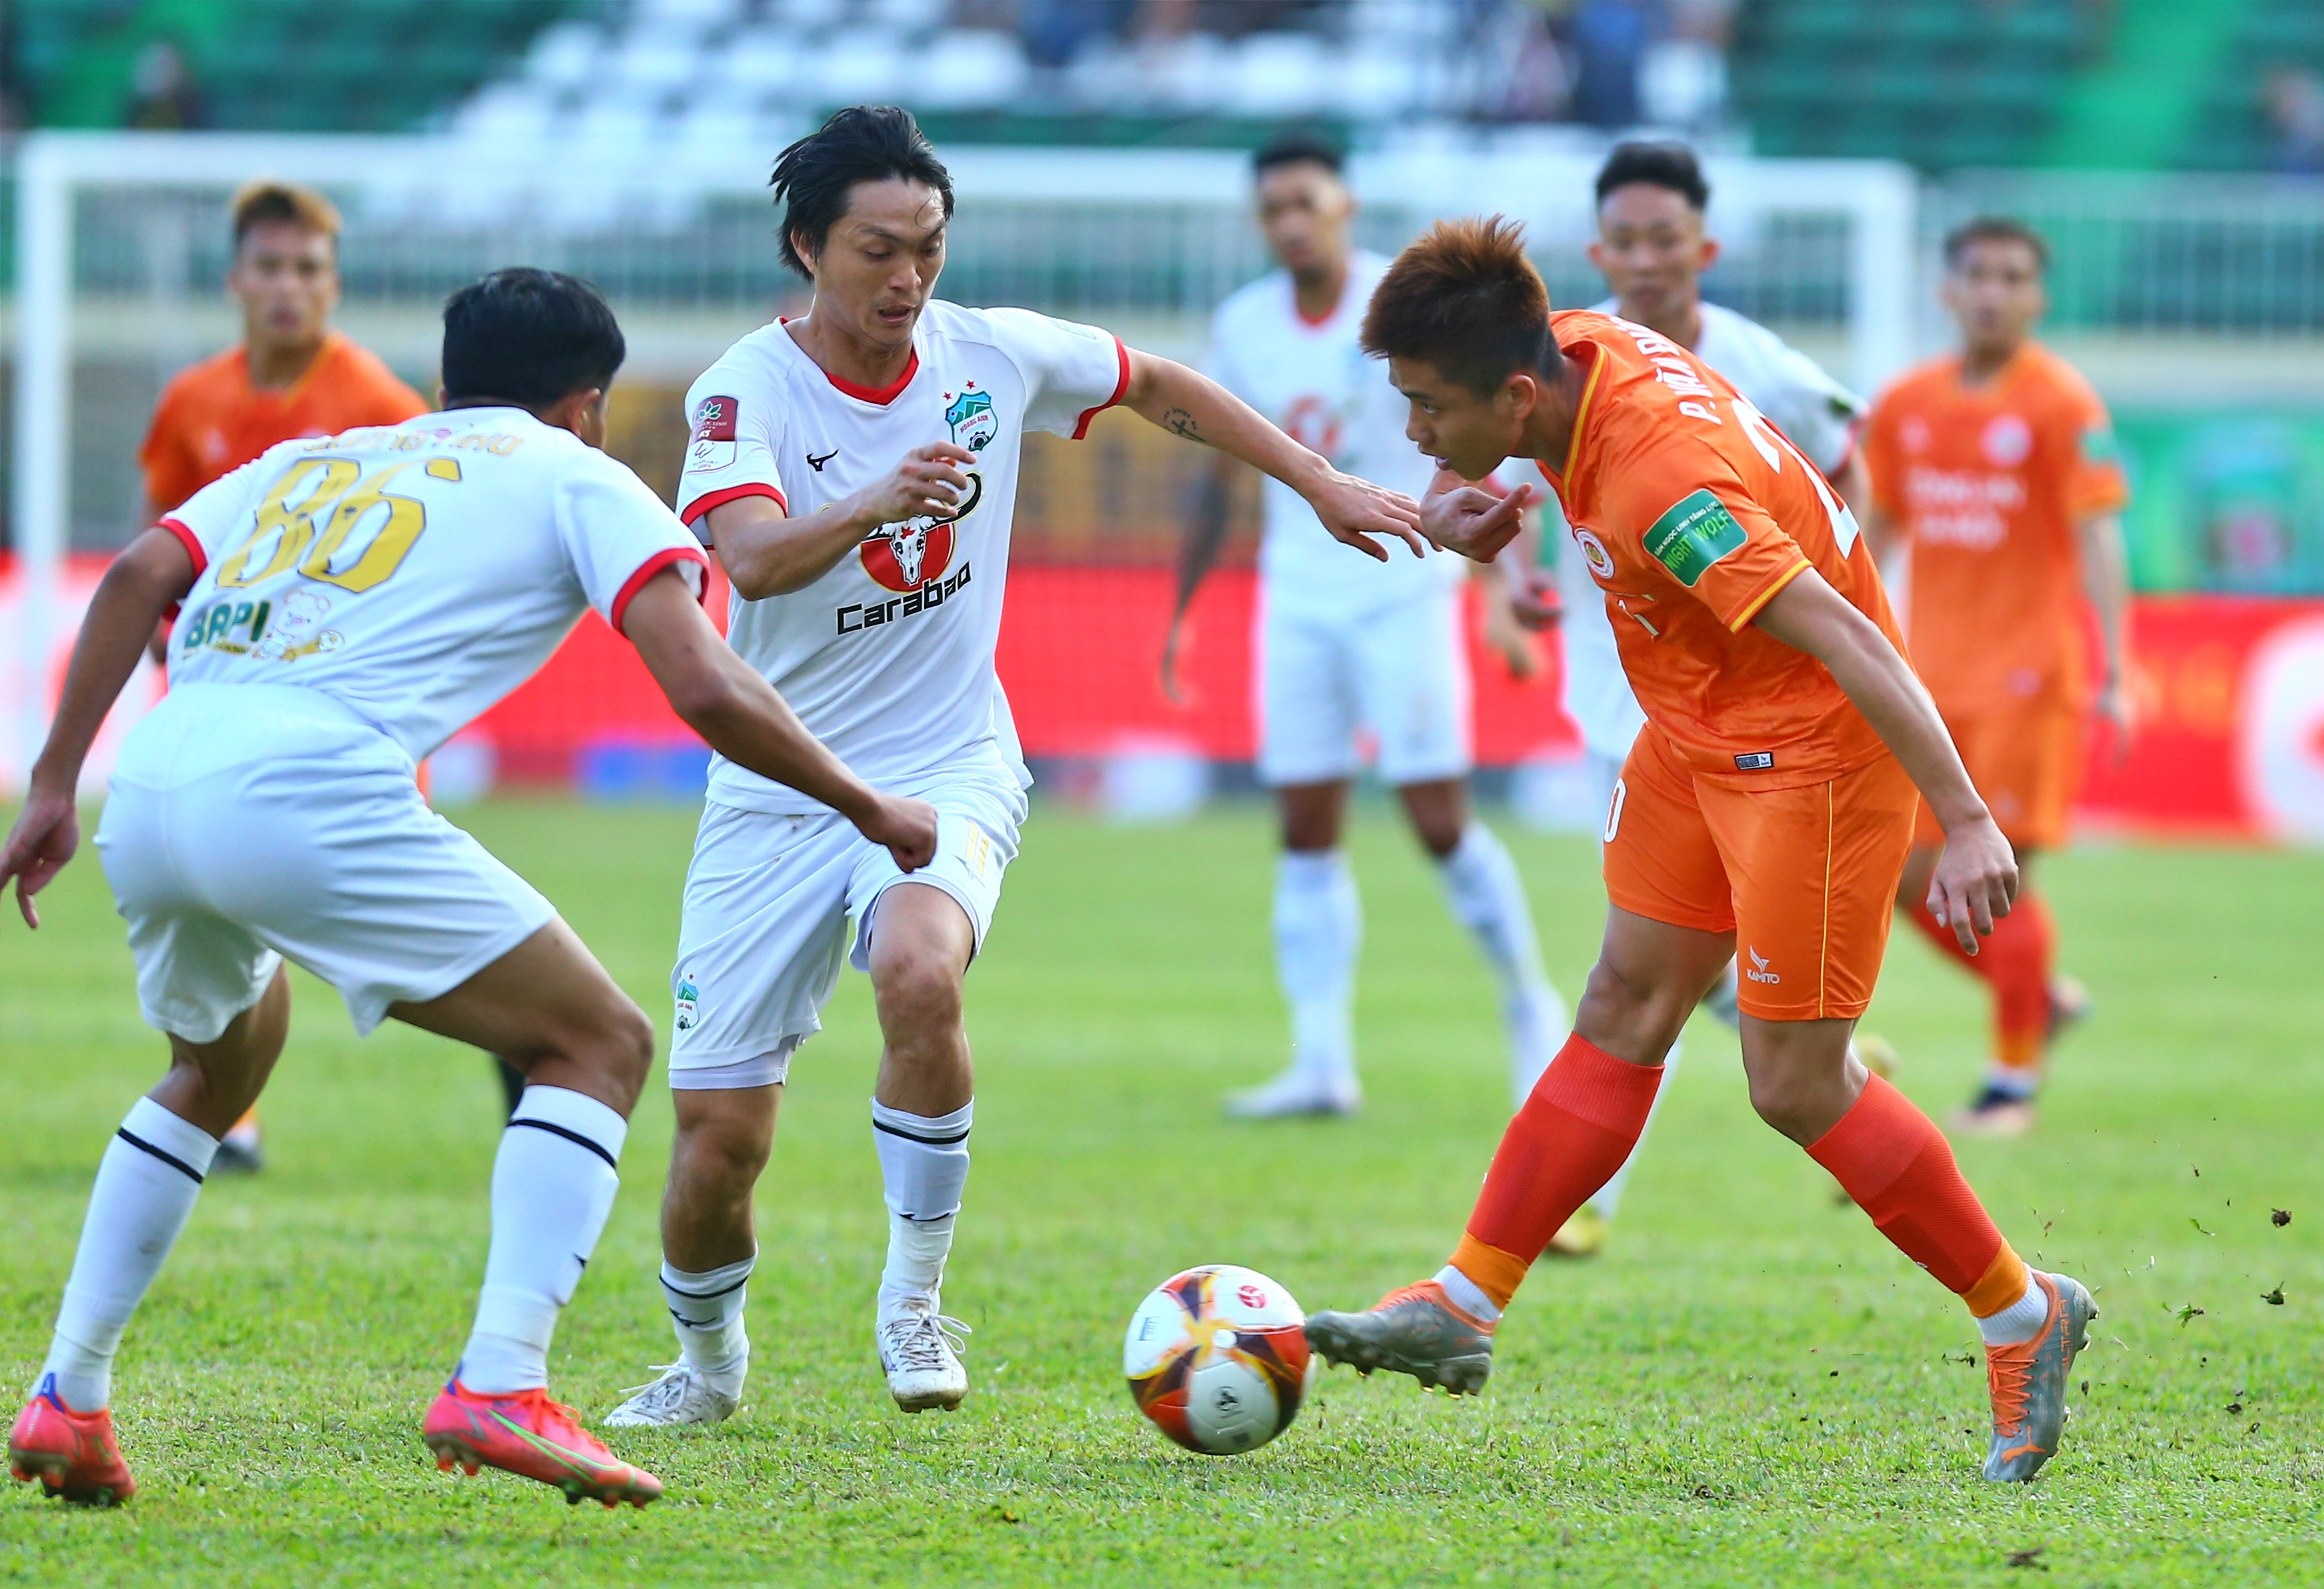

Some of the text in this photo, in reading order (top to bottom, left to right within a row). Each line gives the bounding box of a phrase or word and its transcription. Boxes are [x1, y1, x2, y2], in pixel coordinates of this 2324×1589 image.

[215, 456, 462, 594] 86
[1663, 510, 1730, 570] NIGHT WOLF
[837, 560, 972, 636] Carabao
[1746, 968, 1780, 985] KAMITO
